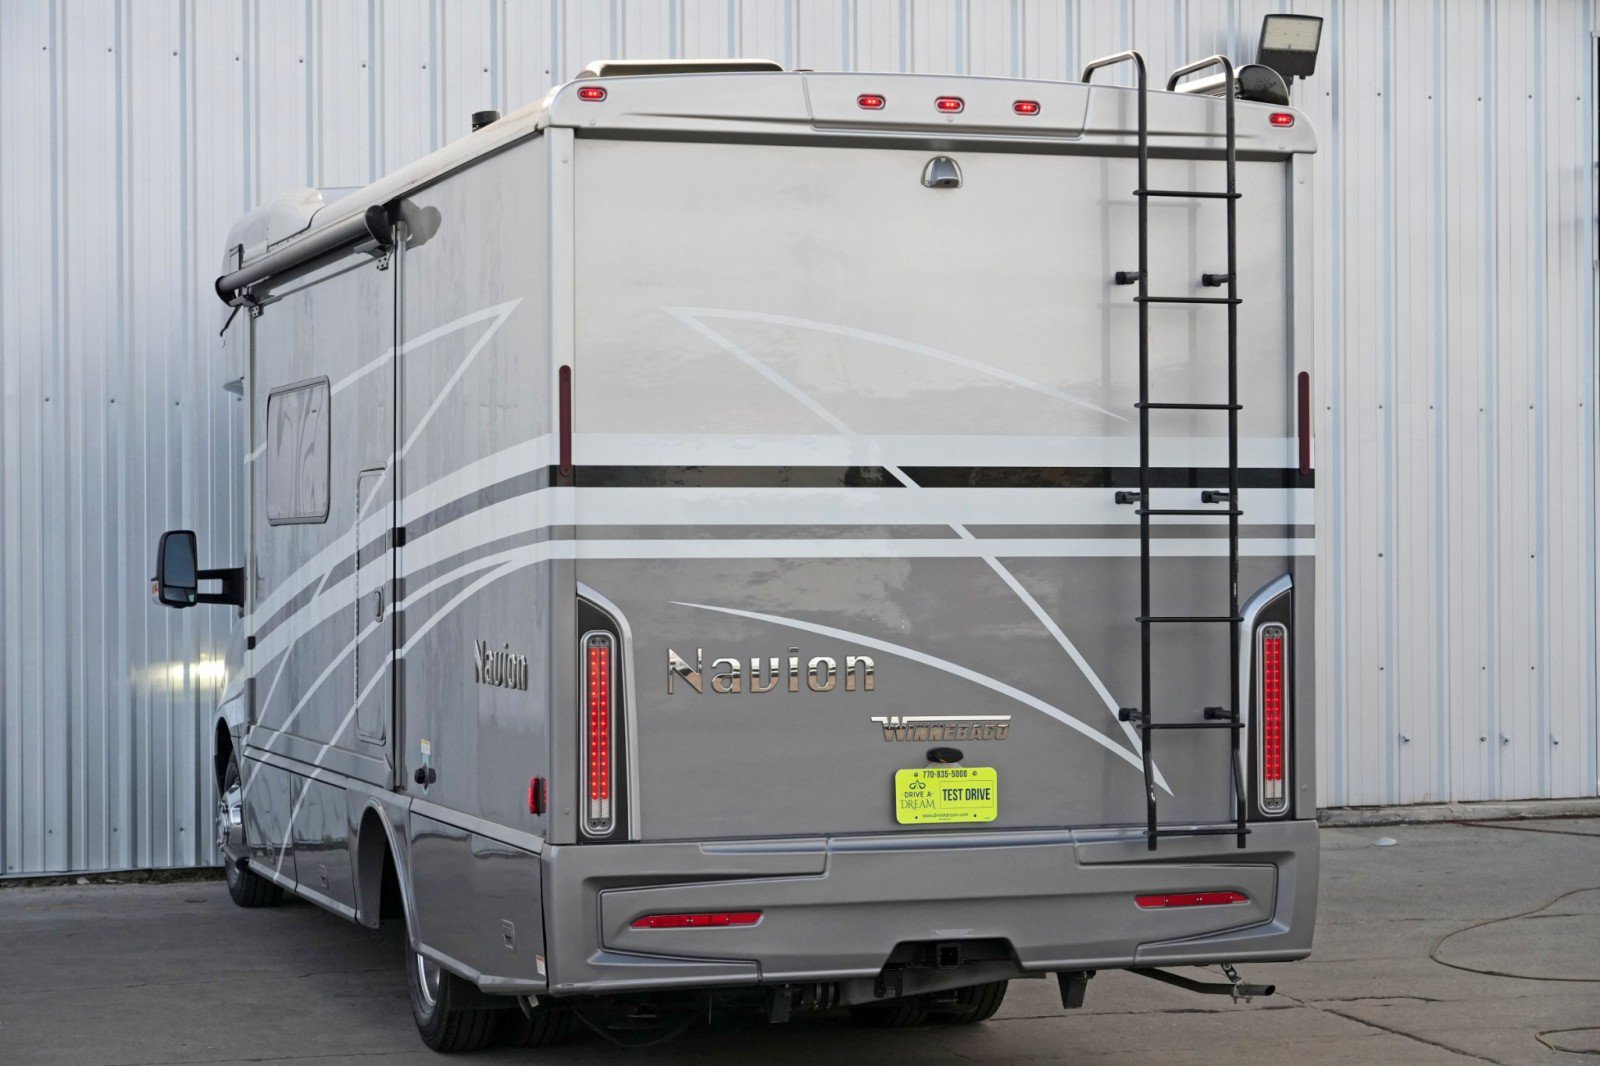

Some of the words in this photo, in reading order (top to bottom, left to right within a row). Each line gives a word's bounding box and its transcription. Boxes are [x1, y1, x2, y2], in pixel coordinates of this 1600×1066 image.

[475, 640, 528, 691] Navion
[667, 647, 875, 694] Navion
[922, 770, 968, 778] 770-835-5000
[942, 788, 963, 801] TEST
[965, 788, 991, 801] DRIVE
[900, 799, 936, 810] DREAM
